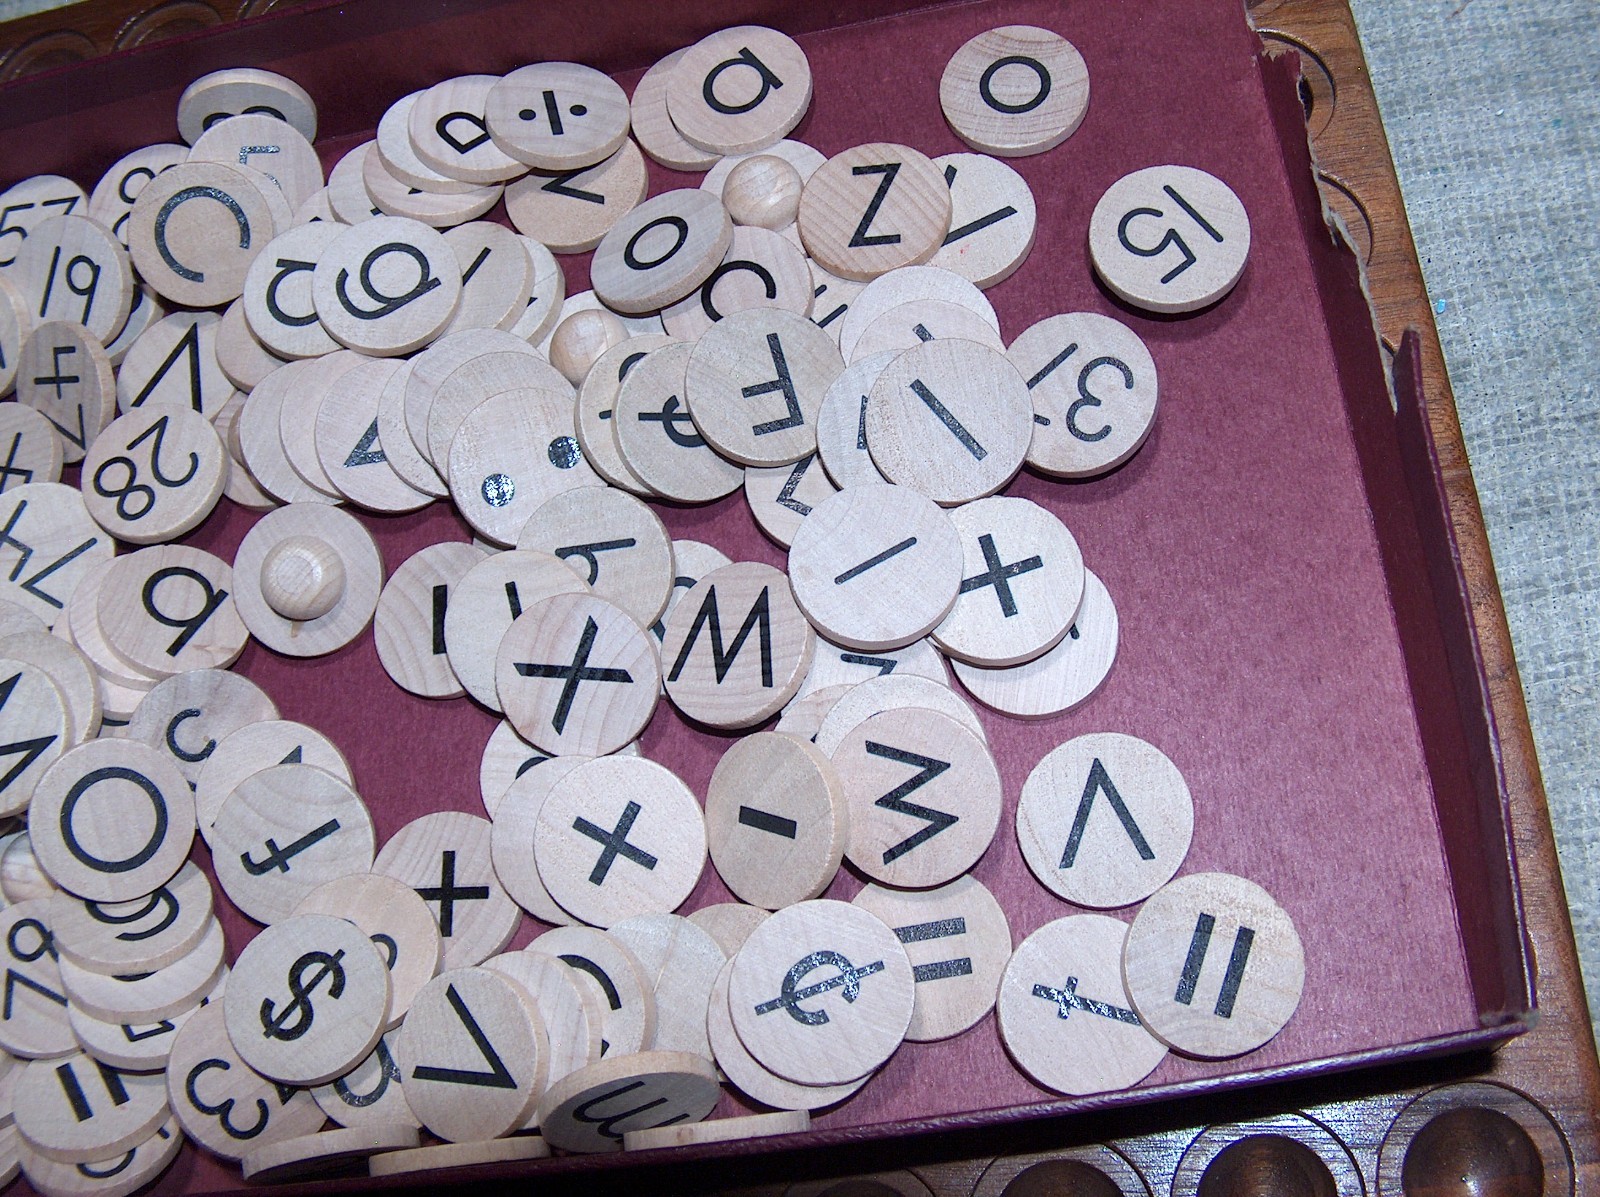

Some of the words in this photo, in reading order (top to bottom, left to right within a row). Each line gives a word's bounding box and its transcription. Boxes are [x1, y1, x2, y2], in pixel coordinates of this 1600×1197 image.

[1117, 184, 1224, 284] 15
[742, 332, 805, 437] F
[259, 948, 346, 1040] $
